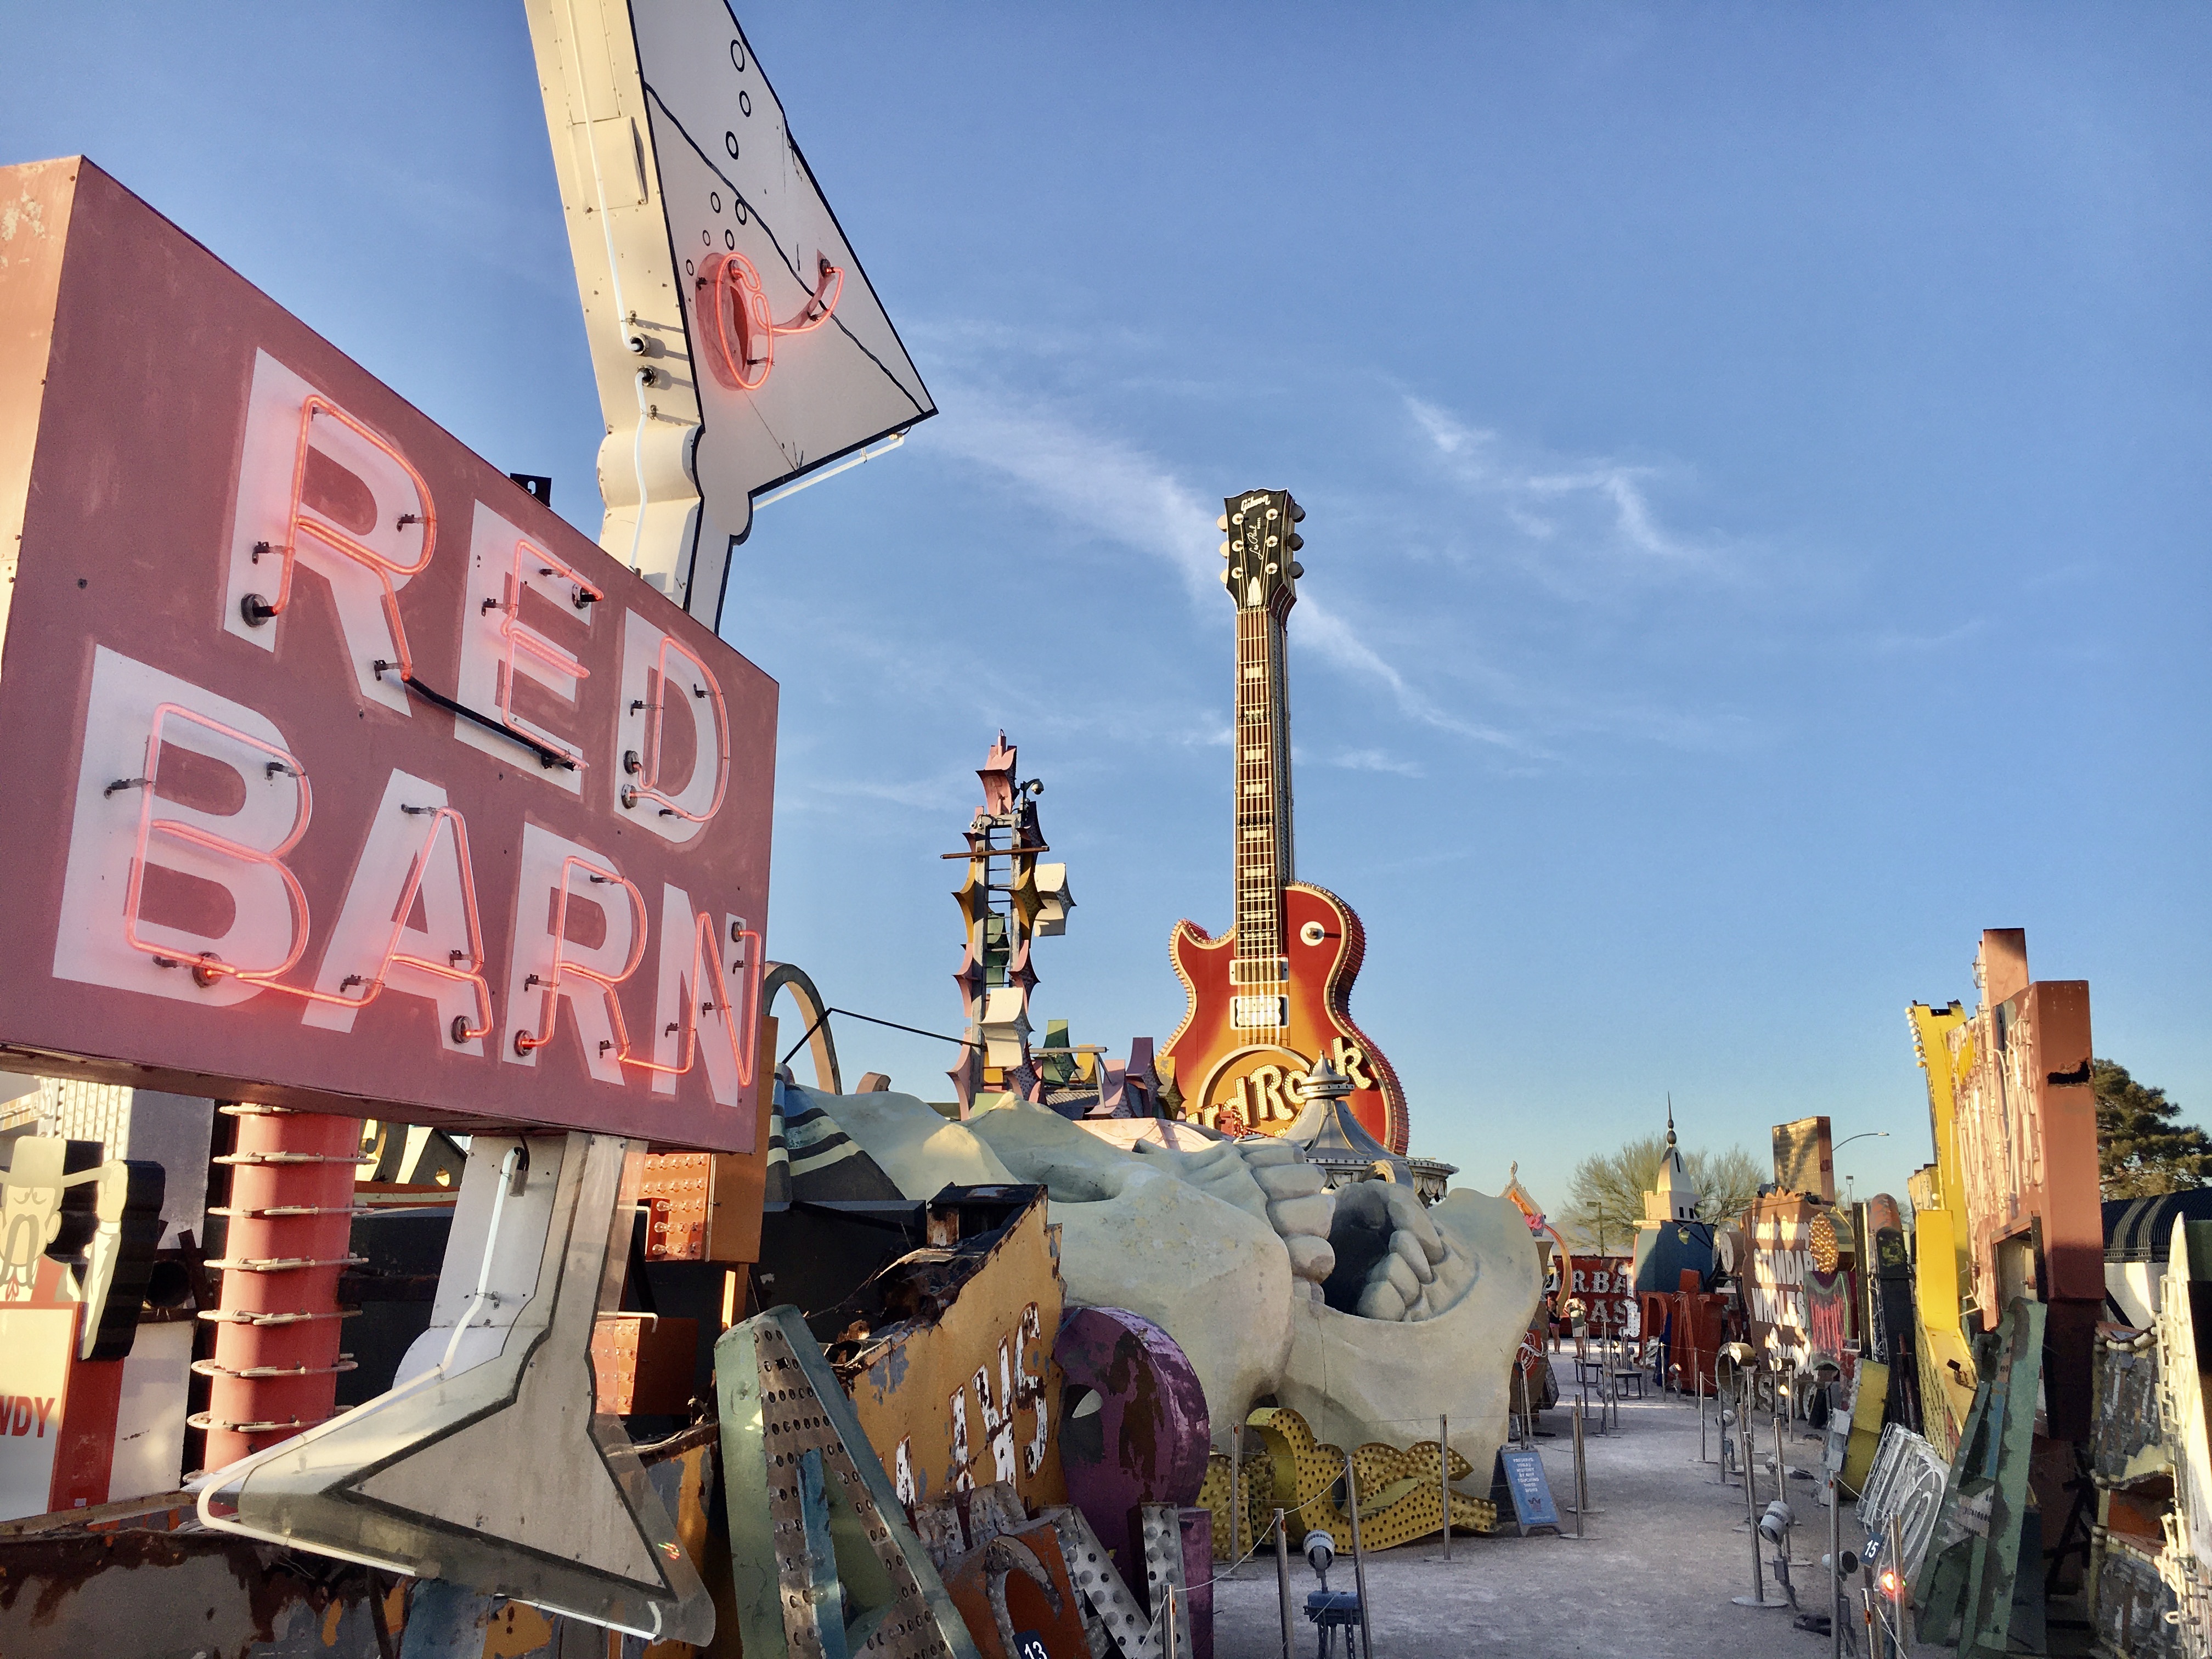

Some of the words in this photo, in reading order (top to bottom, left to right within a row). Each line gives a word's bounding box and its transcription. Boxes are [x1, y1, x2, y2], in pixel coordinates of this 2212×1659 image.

[1240, 494, 1271, 515] Gibson
[1246, 525, 1258, 544] Paul
[222, 346, 731, 844] RED
[52, 643, 762, 1107] BARN
[1581, 1299, 1626, 1324] AS
[1865, 1539, 1879, 1558] 15
[1024, 1641, 1047, 1659] 13
